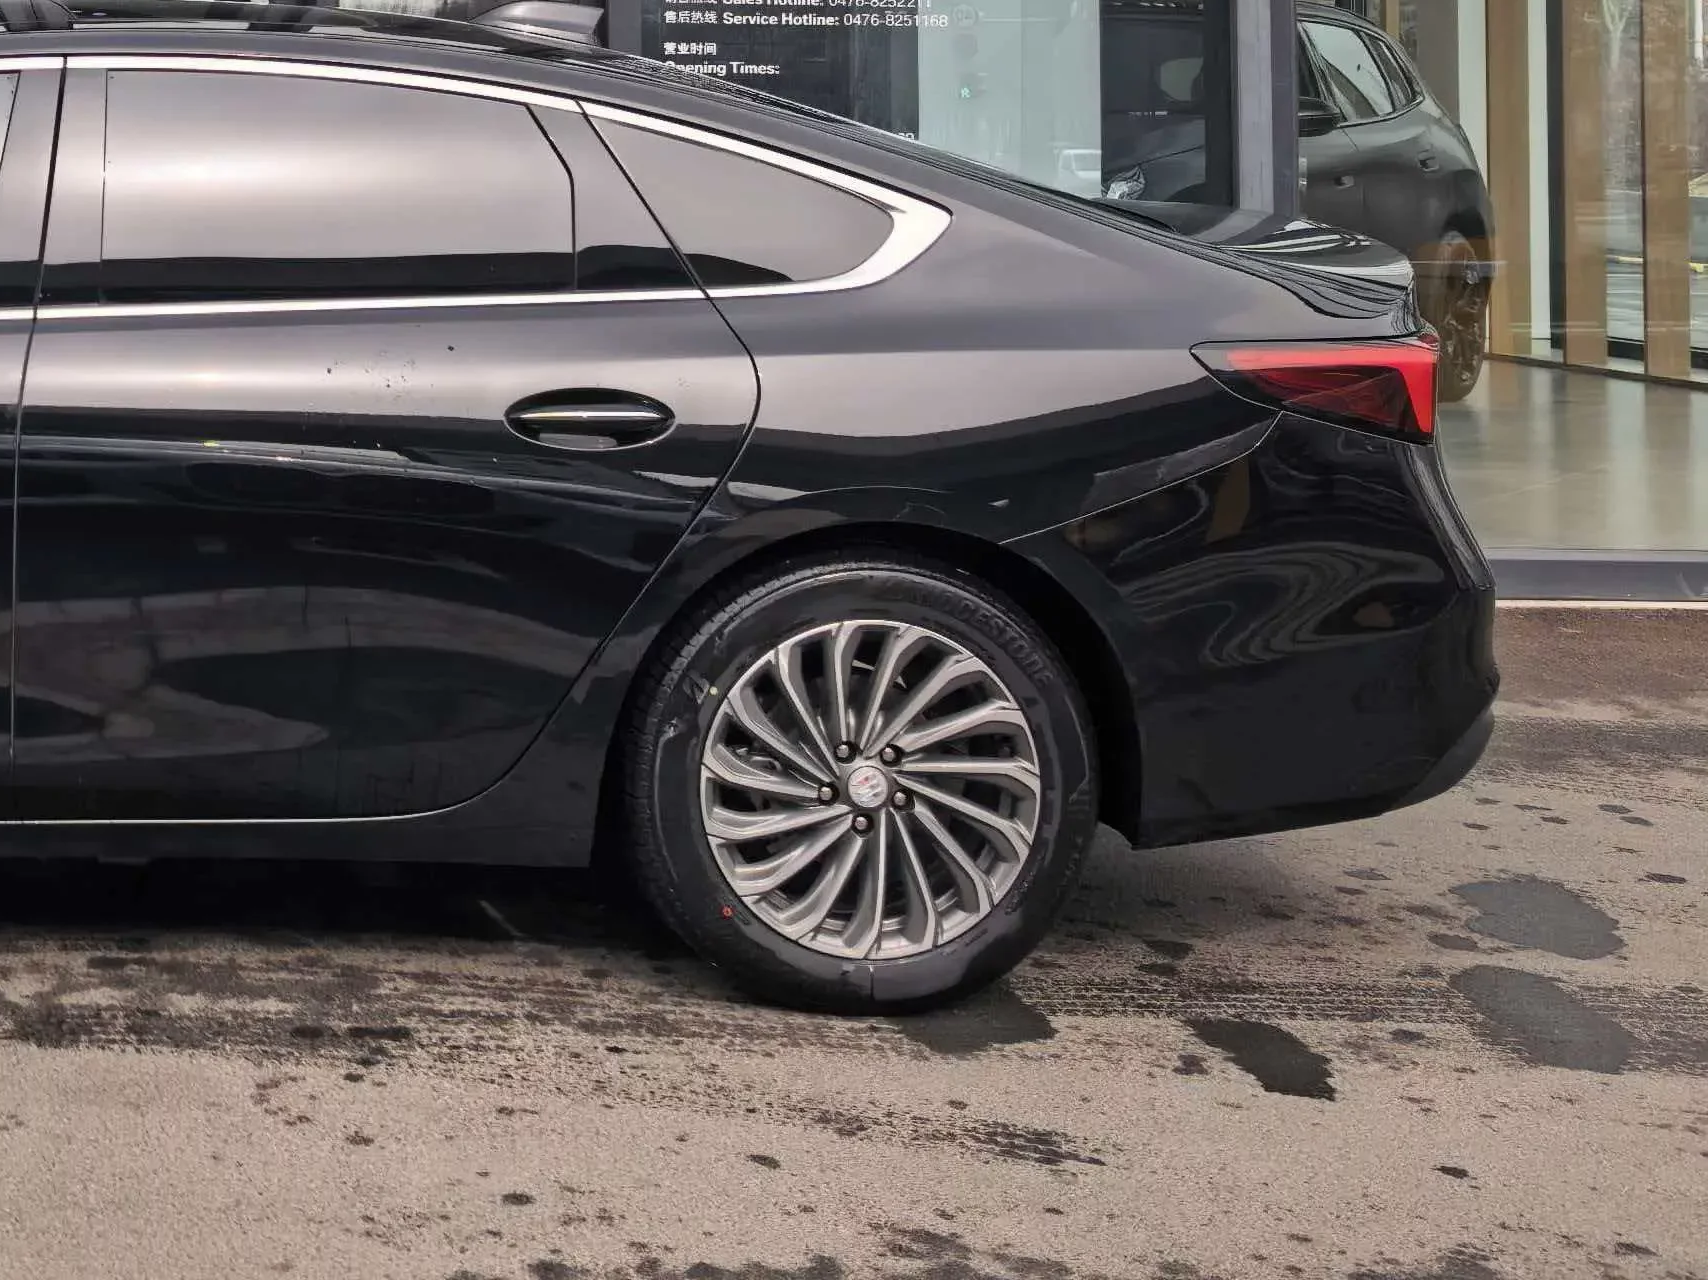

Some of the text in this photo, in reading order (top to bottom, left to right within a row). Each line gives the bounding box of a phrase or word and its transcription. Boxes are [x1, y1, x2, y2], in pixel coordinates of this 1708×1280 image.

[664, 10, 949, 27] 售后热线 Service Hotline: 0476-8251168
[664, 42, 717, 56] 营业时间
[729, 62, 780, 75] Times:
